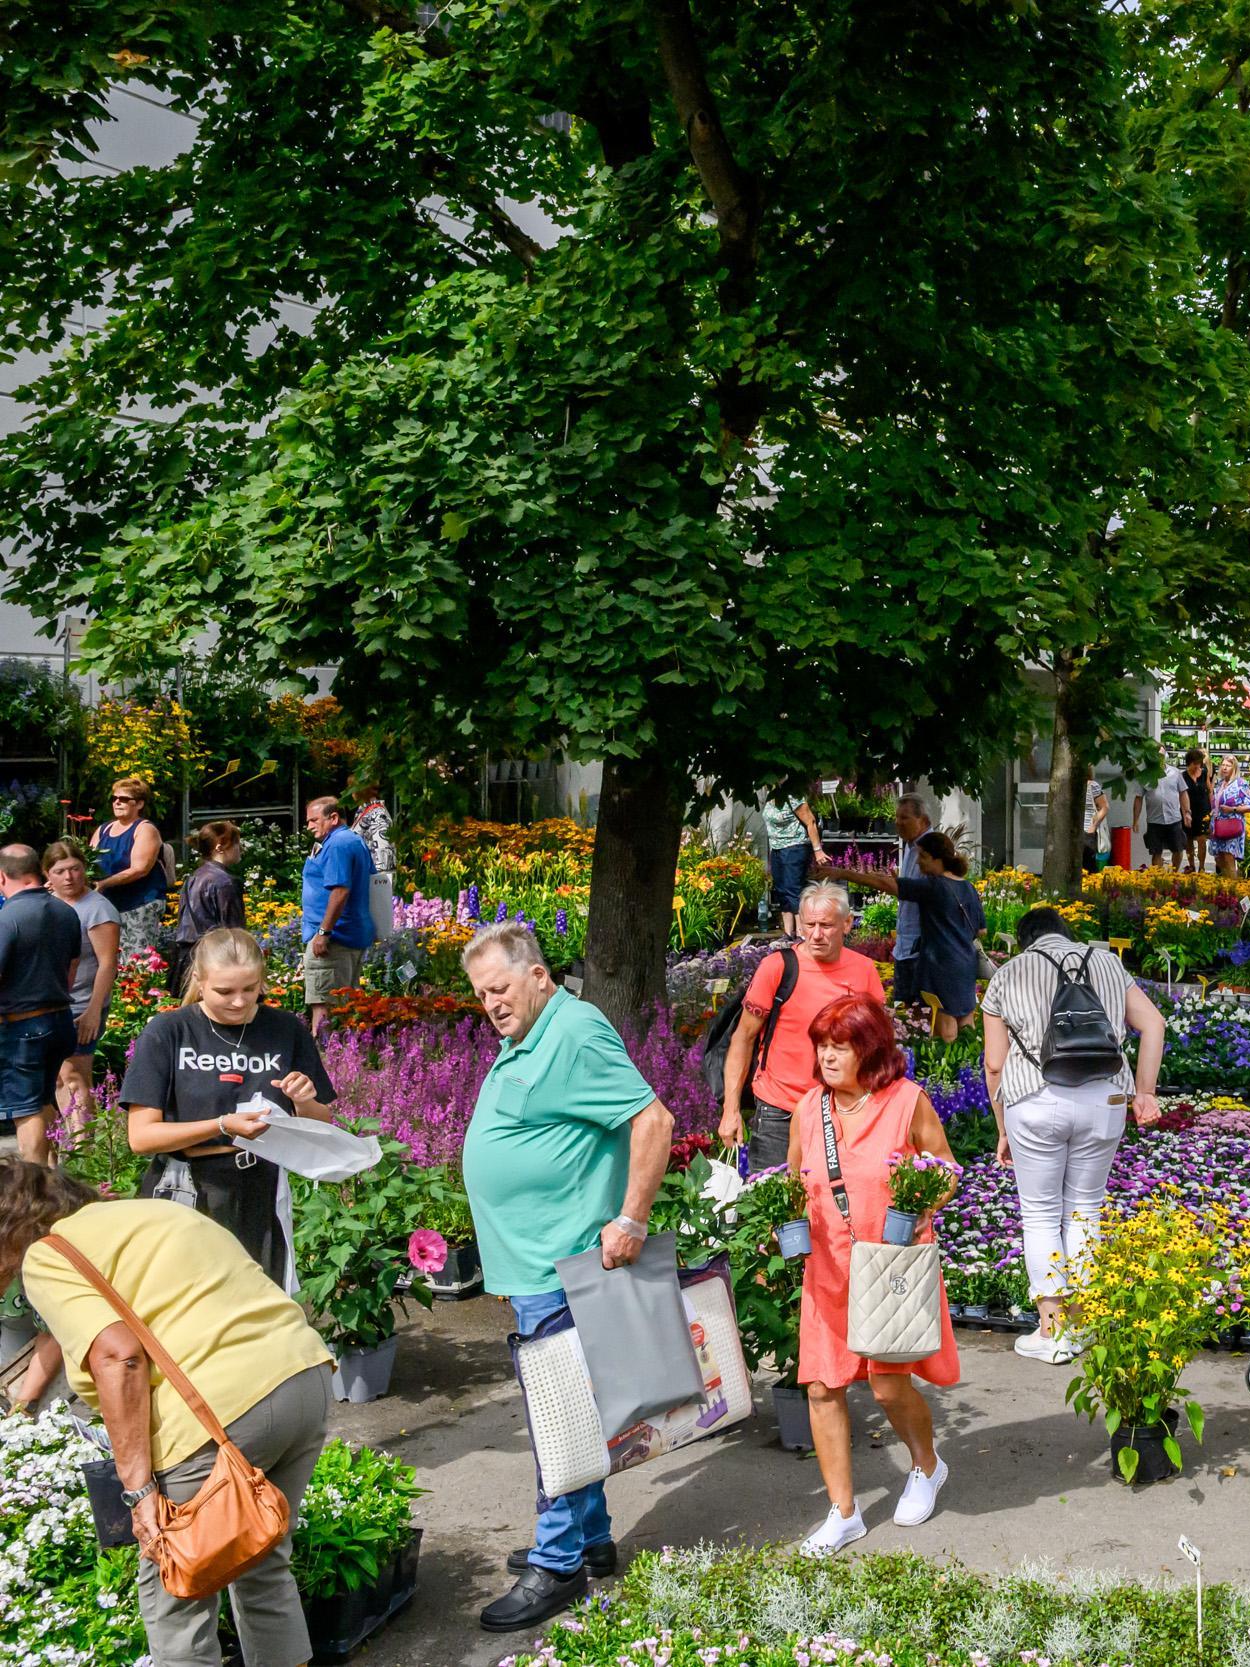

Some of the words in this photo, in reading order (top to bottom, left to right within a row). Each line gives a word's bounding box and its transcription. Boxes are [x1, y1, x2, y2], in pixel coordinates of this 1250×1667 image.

[178, 1047, 281, 1073] Reebok
[822, 1094, 832, 1123] BAGS
[824, 1123, 839, 1170] FASHION
